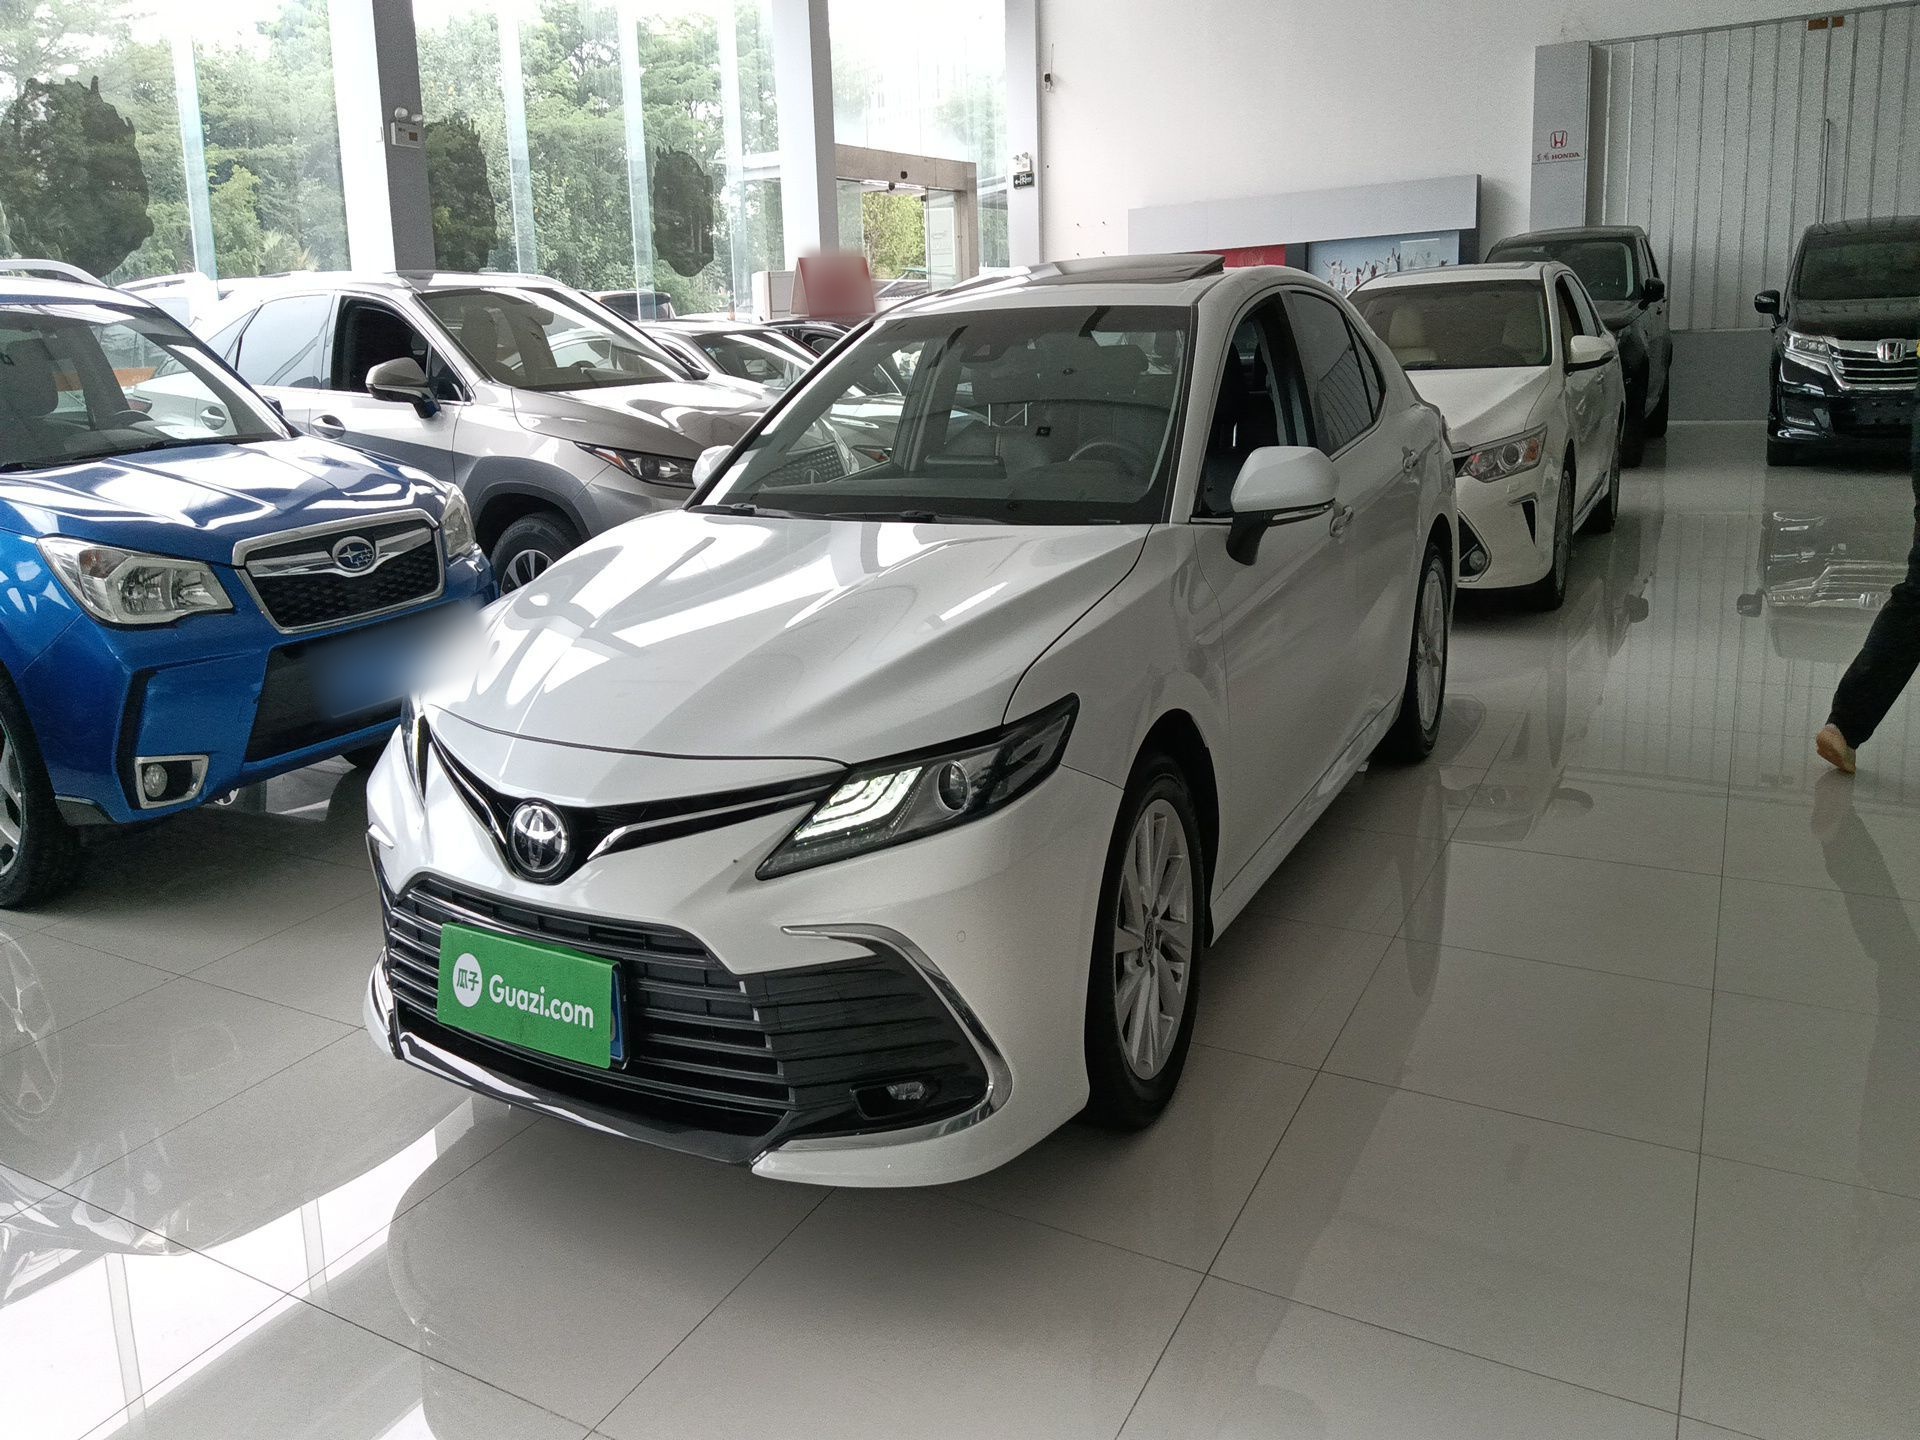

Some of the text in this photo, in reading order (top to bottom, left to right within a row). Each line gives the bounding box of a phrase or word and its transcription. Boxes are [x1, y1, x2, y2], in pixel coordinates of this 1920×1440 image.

[1551, 152, 1580, 160] HONDA
[456, 968, 480, 991] 瓜子
[488, 974, 594, 1028] Guazi.com
